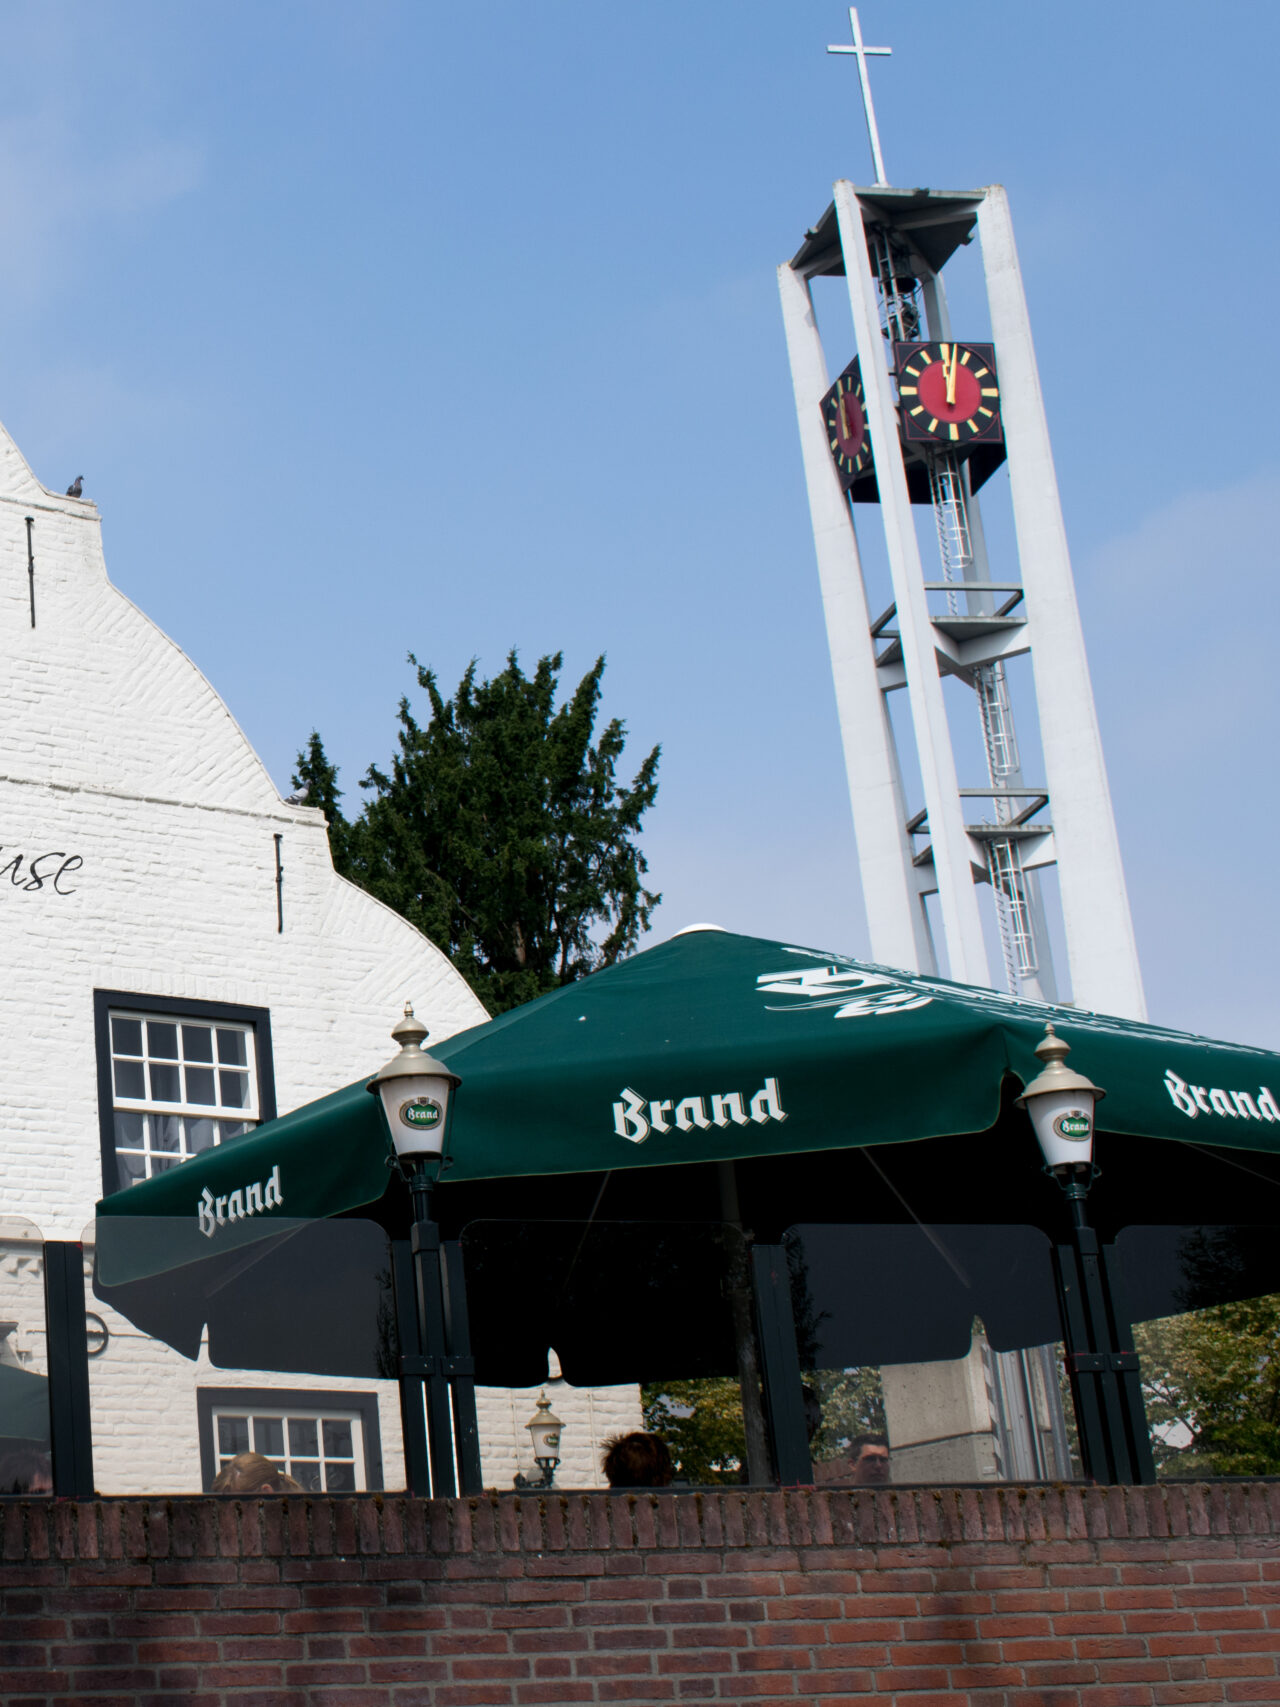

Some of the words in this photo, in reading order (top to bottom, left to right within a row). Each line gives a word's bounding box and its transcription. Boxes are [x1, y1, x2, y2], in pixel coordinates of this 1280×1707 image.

[408, 1107, 438, 1120] Brand
[612, 1077, 789, 1144] Brand
[1163, 1068, 1280, 1123] Brand
[198, 1164, 284, 1239] Brand
